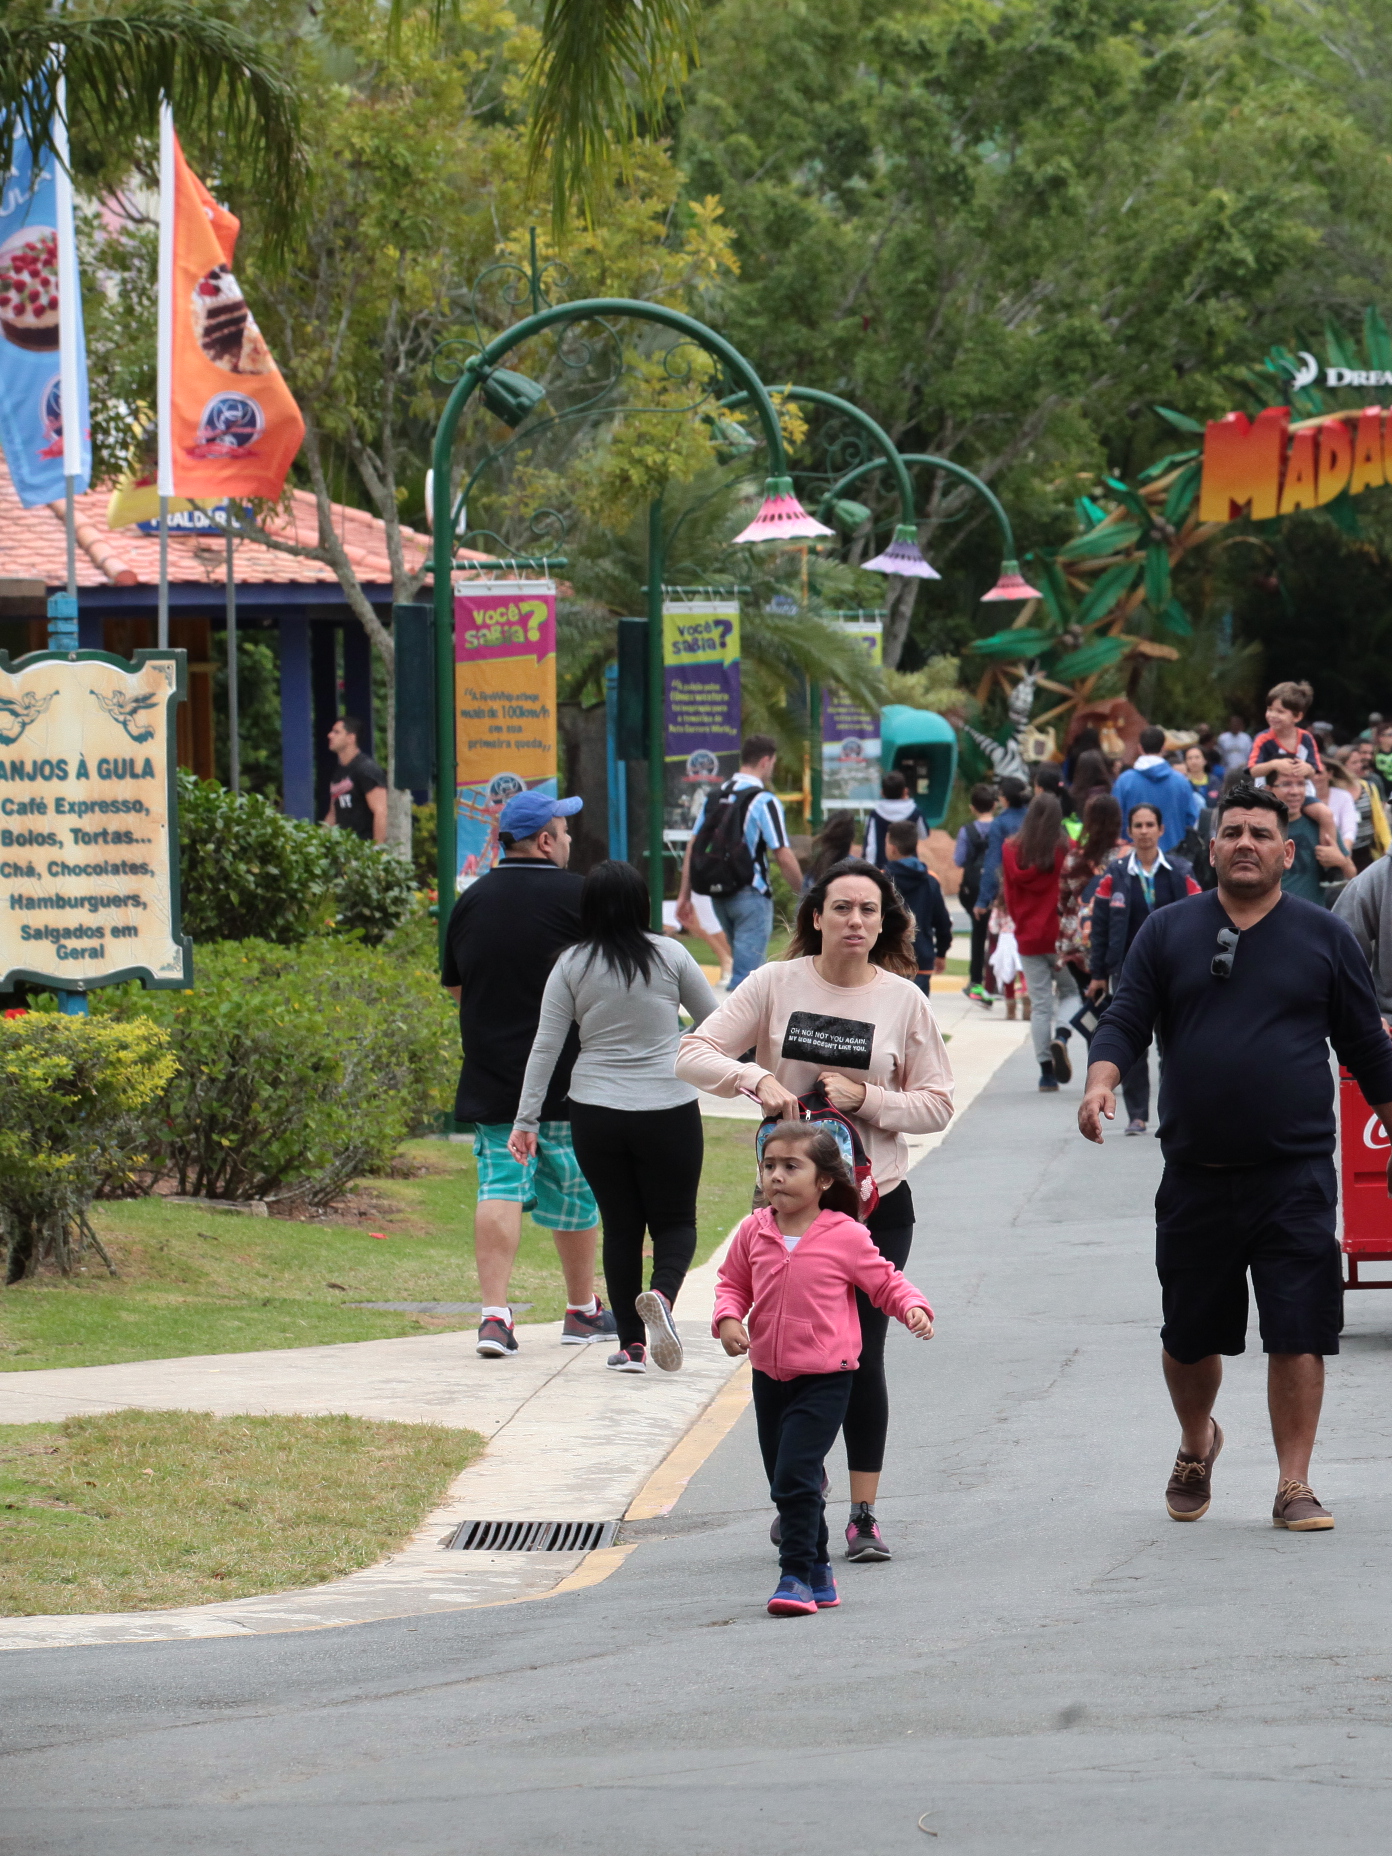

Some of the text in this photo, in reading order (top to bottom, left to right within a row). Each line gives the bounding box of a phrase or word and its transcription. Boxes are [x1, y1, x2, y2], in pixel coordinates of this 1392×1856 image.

[76, 752, 90, 780] À
[97, 757, 155, 780] GULA
[1, 796, 151, 819] Café Expresso,
[0, 827, 152, 850] Bolos, Tortas...
[0, 859, 155, 881] Chá, Chocolates,
[10, 892, 148, 913] Hamburguers,
[20, 923, 139, 944] Salgados em
[56, 943, 105, 960] Geral
[790, 1027, 800, 1035] OH
[801, 1029, 814, 1037] NO!
[815, 1031, 829, 1039] NOT
[830, 1034, 845, 1043] YOU
